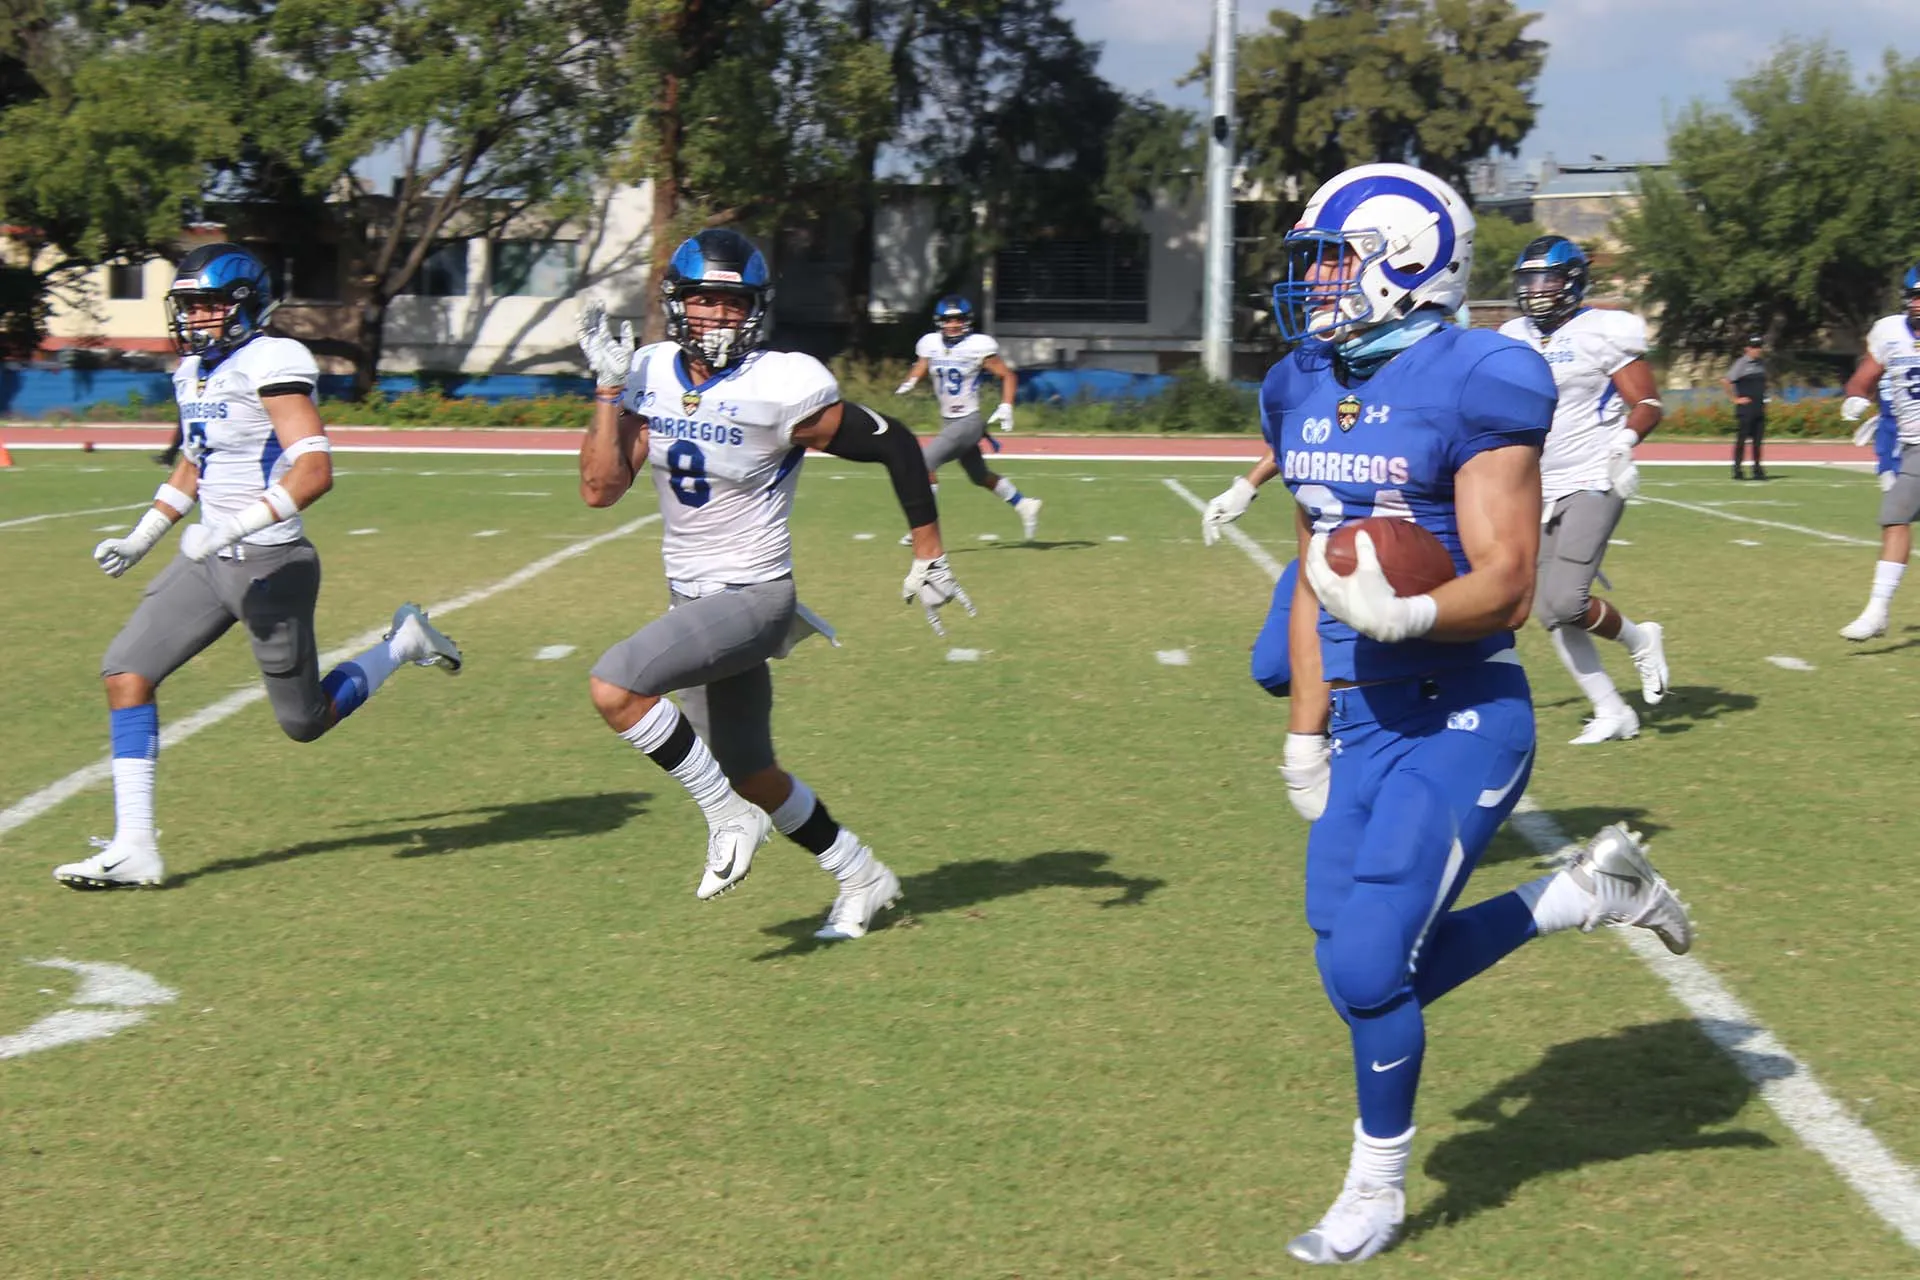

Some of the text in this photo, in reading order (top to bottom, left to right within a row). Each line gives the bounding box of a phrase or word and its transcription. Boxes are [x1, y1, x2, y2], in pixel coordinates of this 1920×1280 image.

[936, 367, 962, 395] 19
[667, 439, 711, 509] 8
[1284, 449, 1409, 485] BORREGOS
